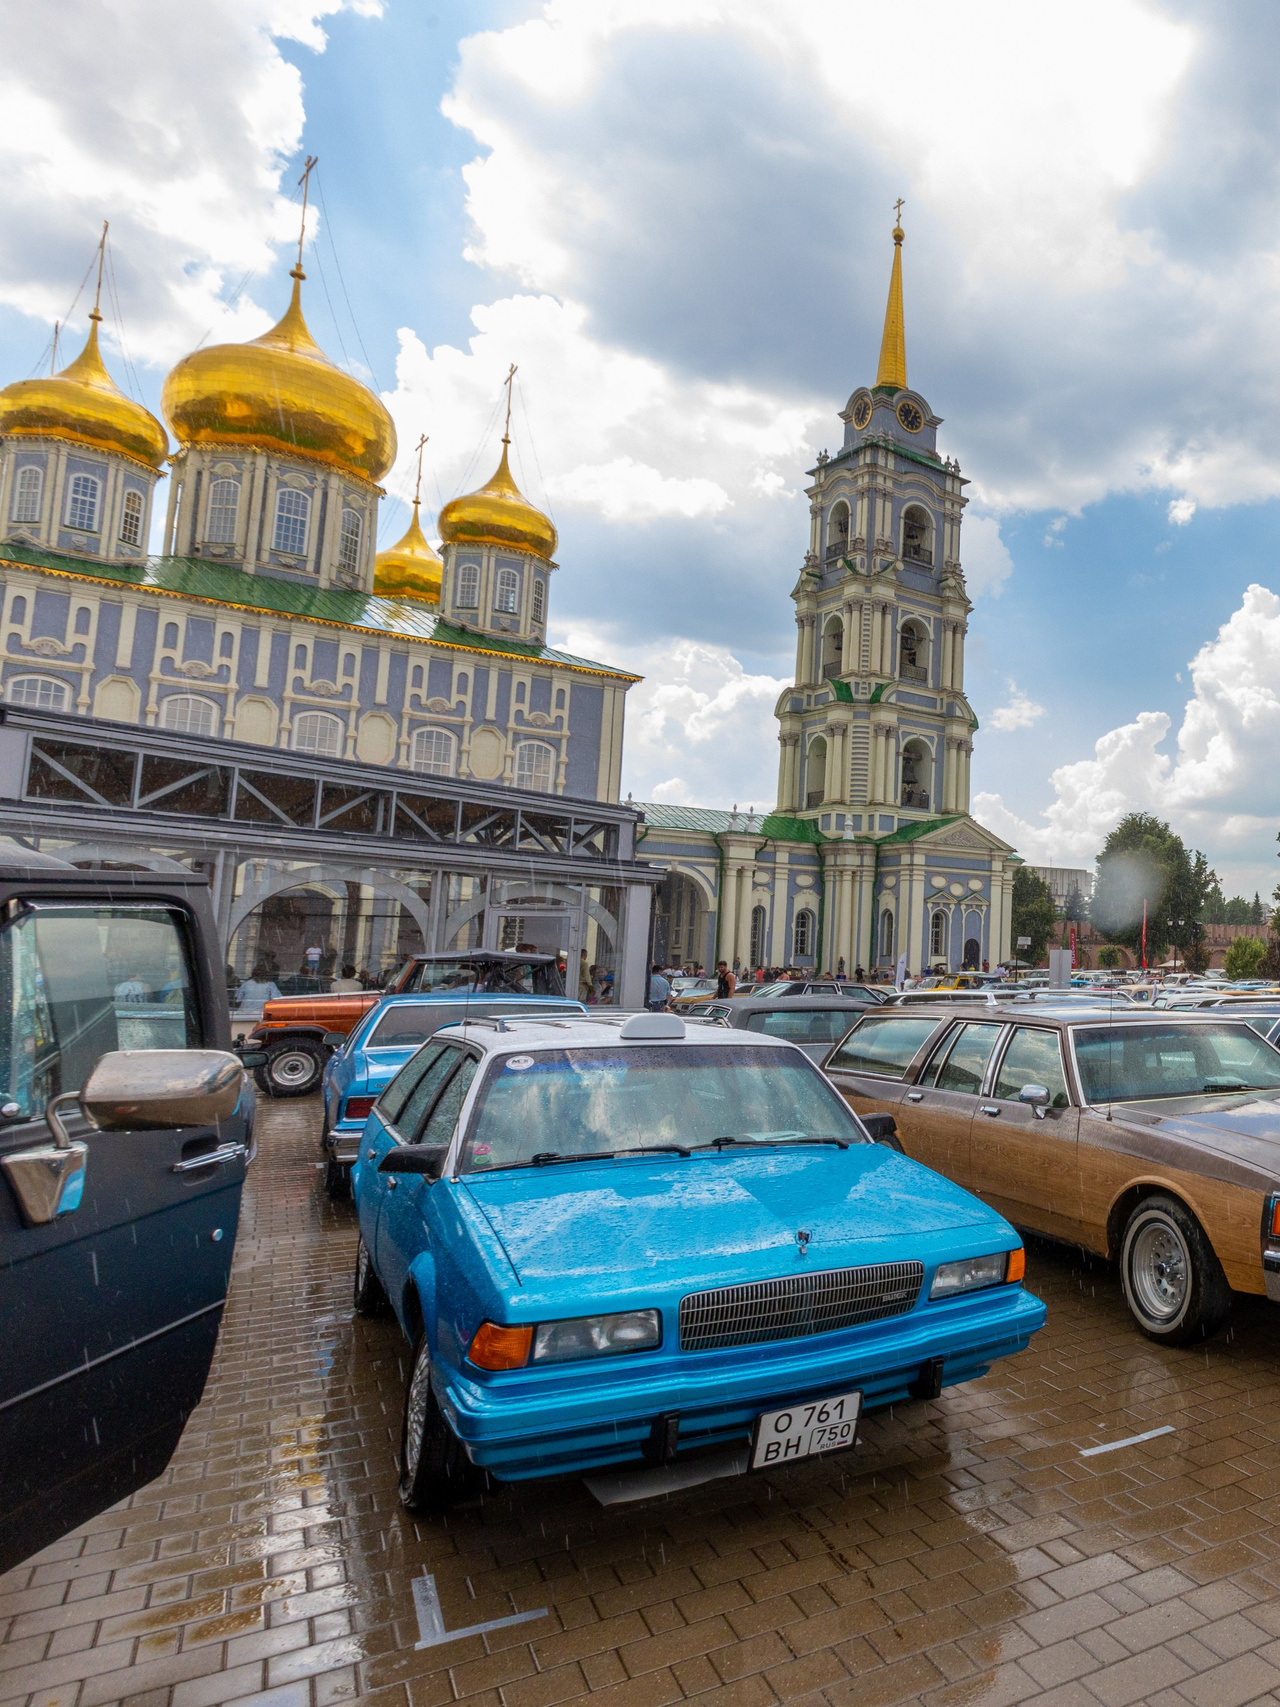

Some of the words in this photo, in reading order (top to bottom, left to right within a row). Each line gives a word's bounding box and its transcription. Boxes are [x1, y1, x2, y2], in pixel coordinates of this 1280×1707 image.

[882, 1291, 908, 1302] BUICK
[804, 1398, 845, 1428] 761
[816, 1423, 851, 1445] 750
[820, 1440, 837, 1449] RUS
